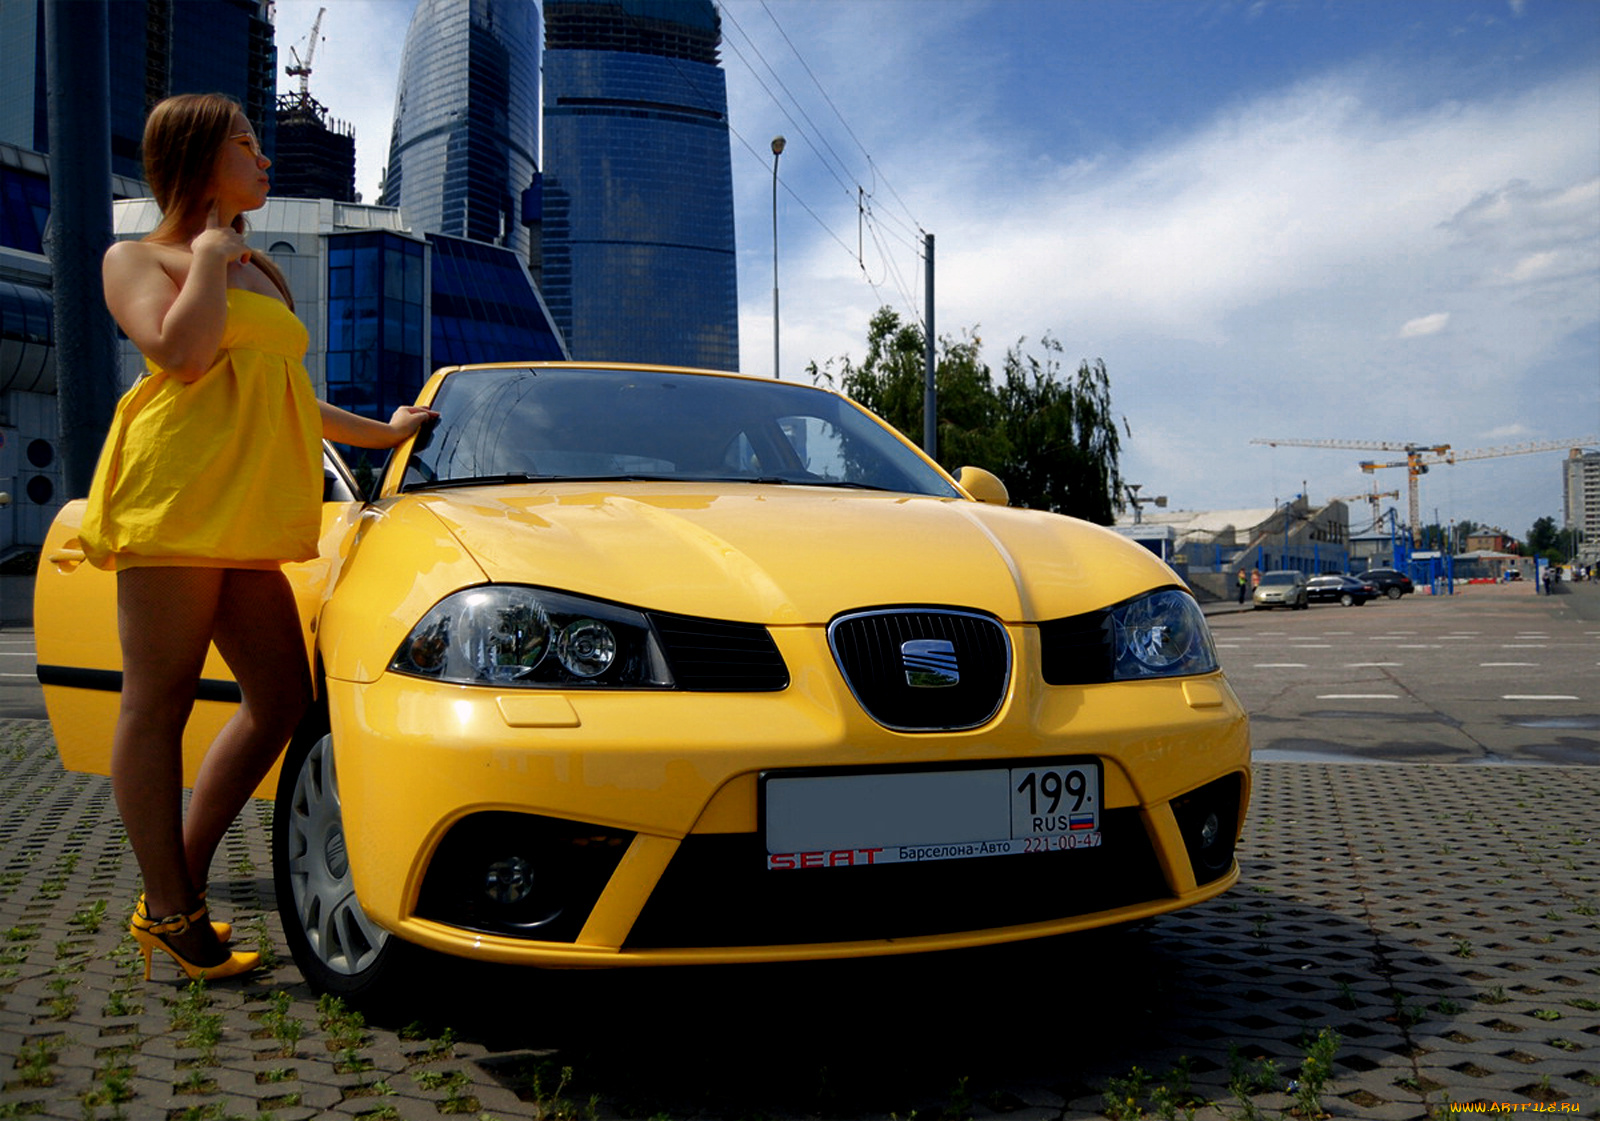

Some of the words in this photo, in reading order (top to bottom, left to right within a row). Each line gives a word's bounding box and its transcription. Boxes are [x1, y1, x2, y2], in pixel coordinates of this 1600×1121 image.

[1033, 815, 1068, 832] RUS
[770, 847, 884, 870] SEAT
[899, 841, 1011, 861] Барселона-Авто
[1023, 832, 1101, 854] 221-00-47
